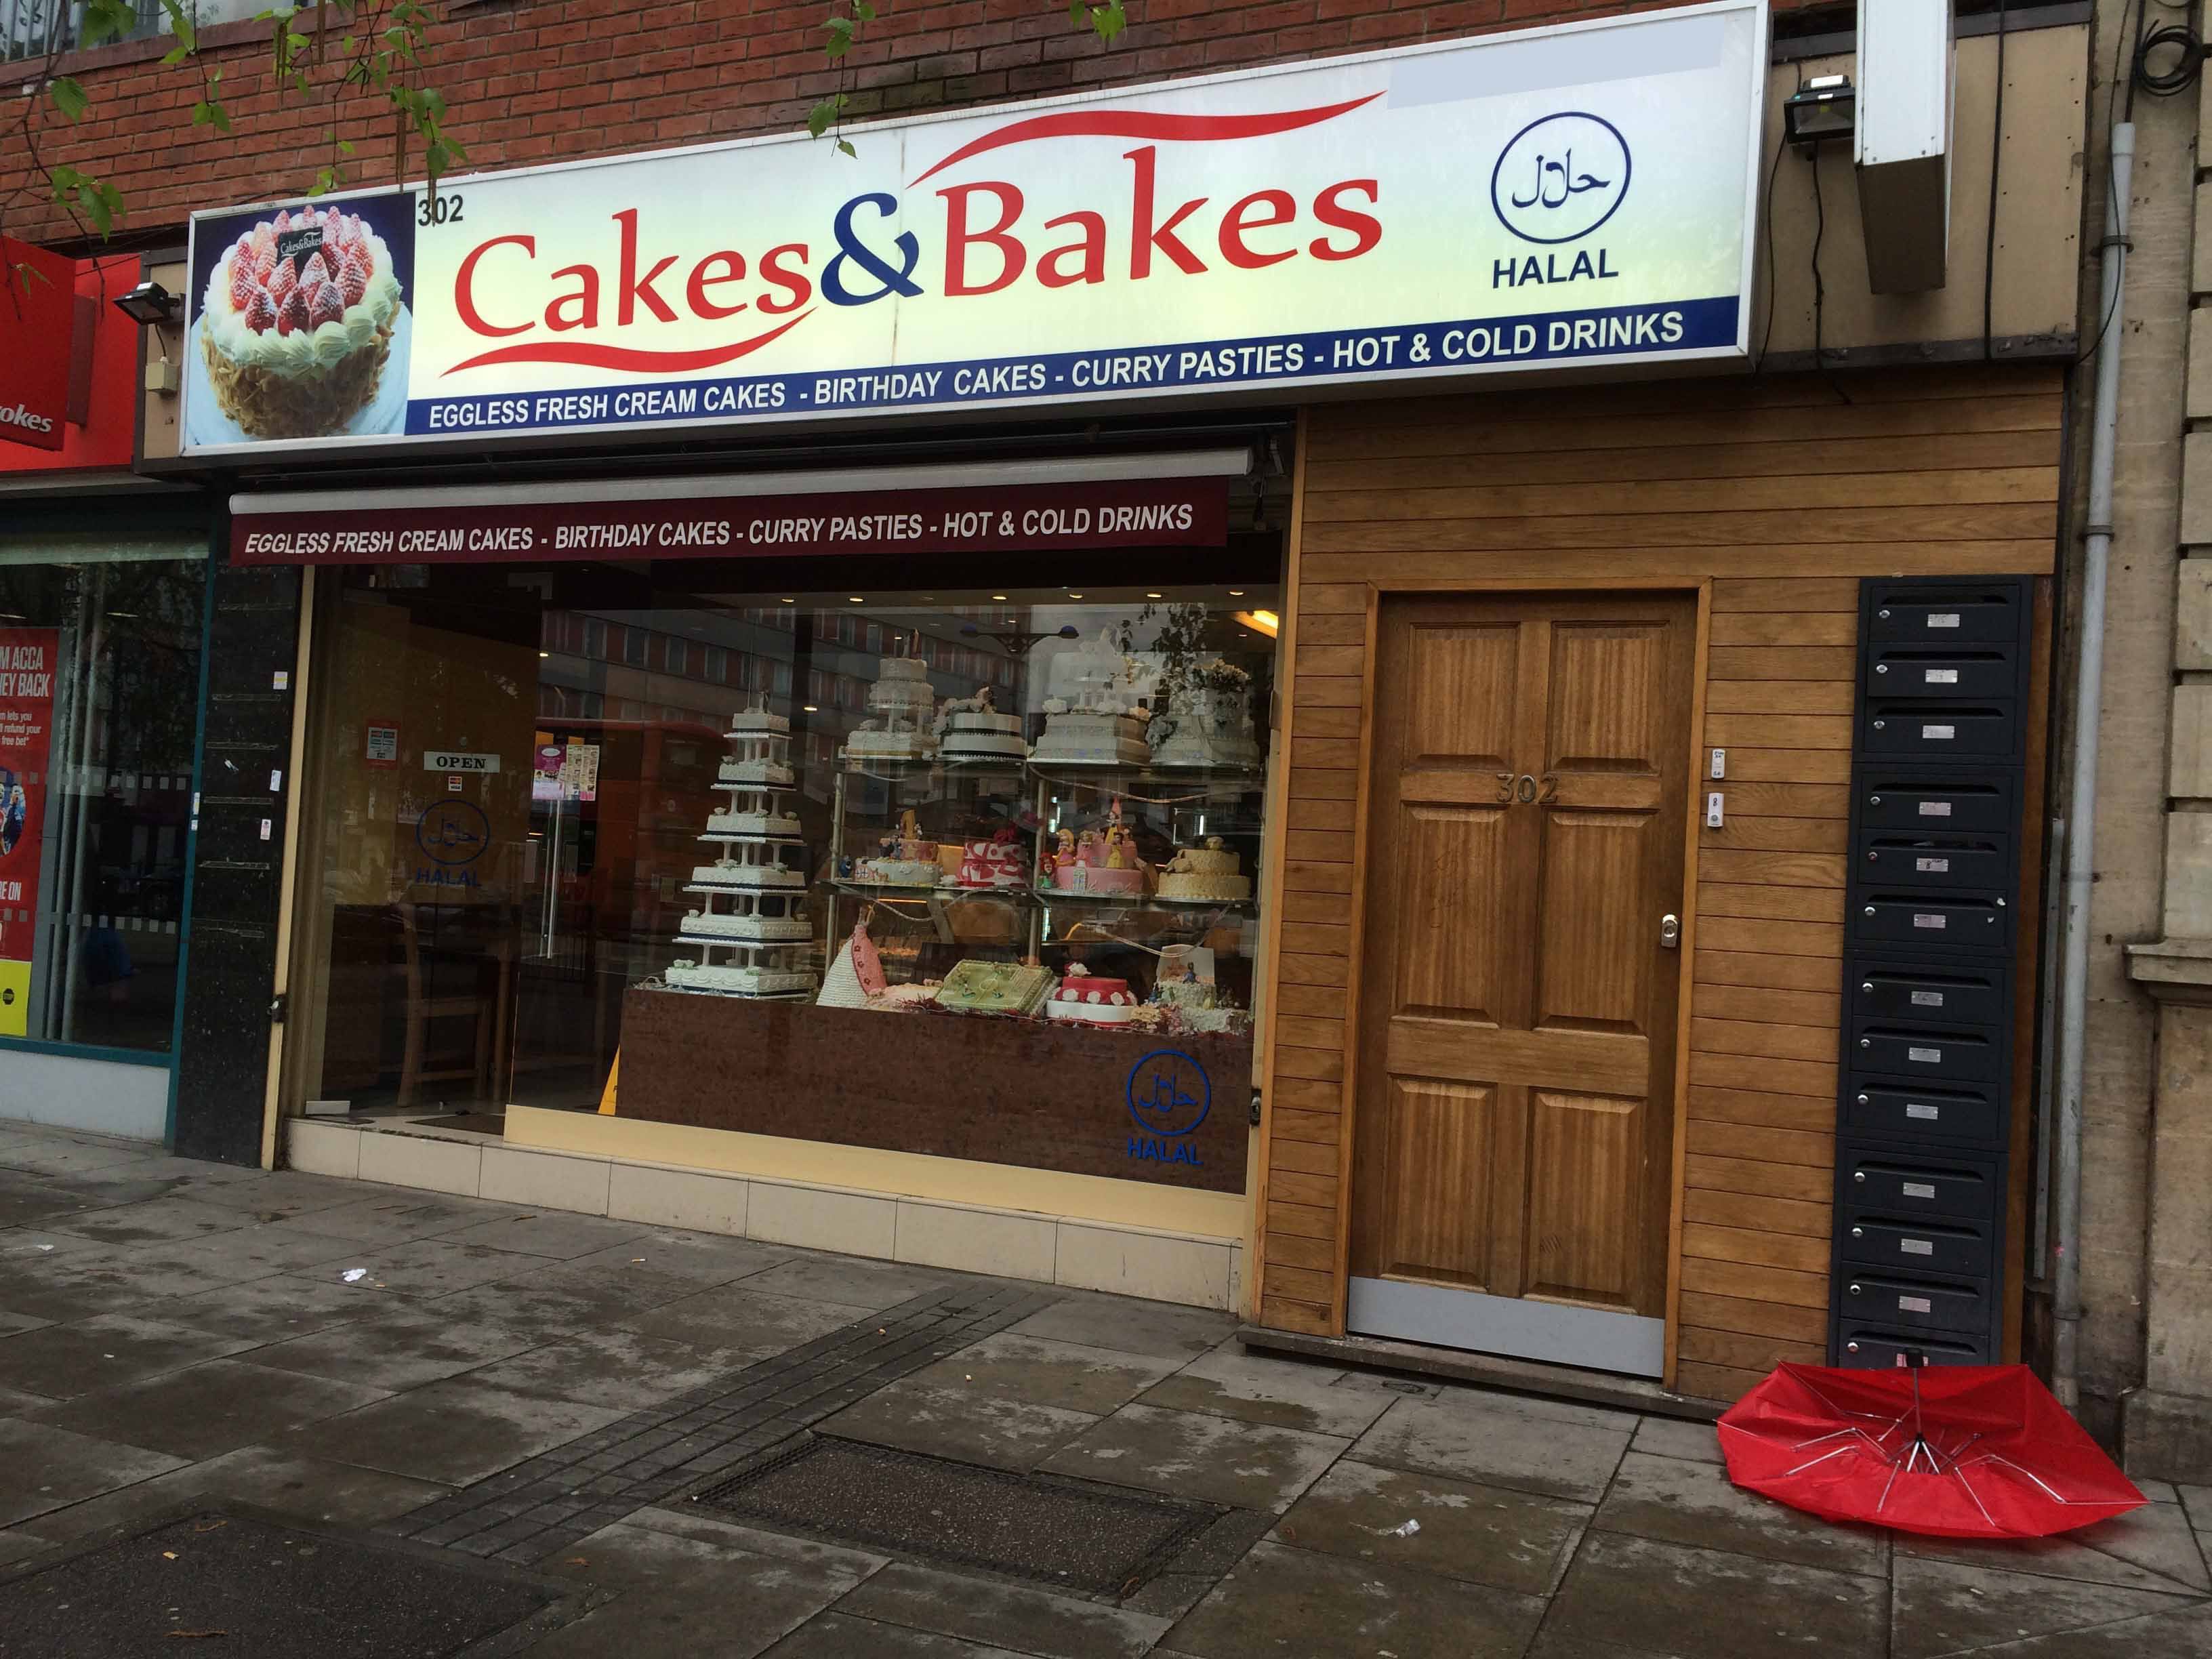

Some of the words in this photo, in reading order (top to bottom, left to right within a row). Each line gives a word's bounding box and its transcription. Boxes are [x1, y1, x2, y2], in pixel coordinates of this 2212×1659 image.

[418, 194, 464, 226] 302
[1492, 248, 1620, 289] HALAL
[429, 401, 529, 428] EGGLESS
[535, 394, 609, 422] FRESH
[614, 388, 697, 417] CREAM
[703, 382, 787, 412] CAKES
[814, 371, 943, 405] BIRTHDAY
[954, 363, 1047, 396] CAKES
[1071, 353, 1172, 387] CURRY
[1178, 343, 1305, 380] PASTIES
[1332, 335, 1401, 368] HOT
[1409, 333, 1432, 363] &
[1441, 324, 1537, 360] COLD
[1547, 310, 1685, 352] DRINKS
[0, 404, 54, 432] okes
[245, 533, 331, 554] EGGLESS
[332, 531, 394, 553] FRESH
[398, 529, 465, 552] CREAM
[468, 527, 533, 550] CAKES
[554, 523, 655, 549] BIRTHDAY
[657, 520, 731, 546] CAKES
[748, 517, 825, 544] CURRY
[828, 514, 923, 541] PASTIES
[943, 512, 994, 538] HOT
[998, 510, 1016, 536] &
[1021, 508, 1090, 535] COLD
[1097, 504, 1193, 533] DRINKS
[12, 646, 44, 671] ACCA
[18, 672, 51, 697] BACK
[5, 723, 25, 733] refund
[26, 726, 41, 735] your
[7, 711, 19, 721] lets
[20, 713, 33, 723] you
[2, 735, 14, 745] free
[436, 756, 487, 769] OPEN
[1496, 773, 1559, 804] 302
[415, 867, 482, 887] HALAL
[8, 882, 22, 901] ON
[1126, 1137, 1205, 1166] HALAL
